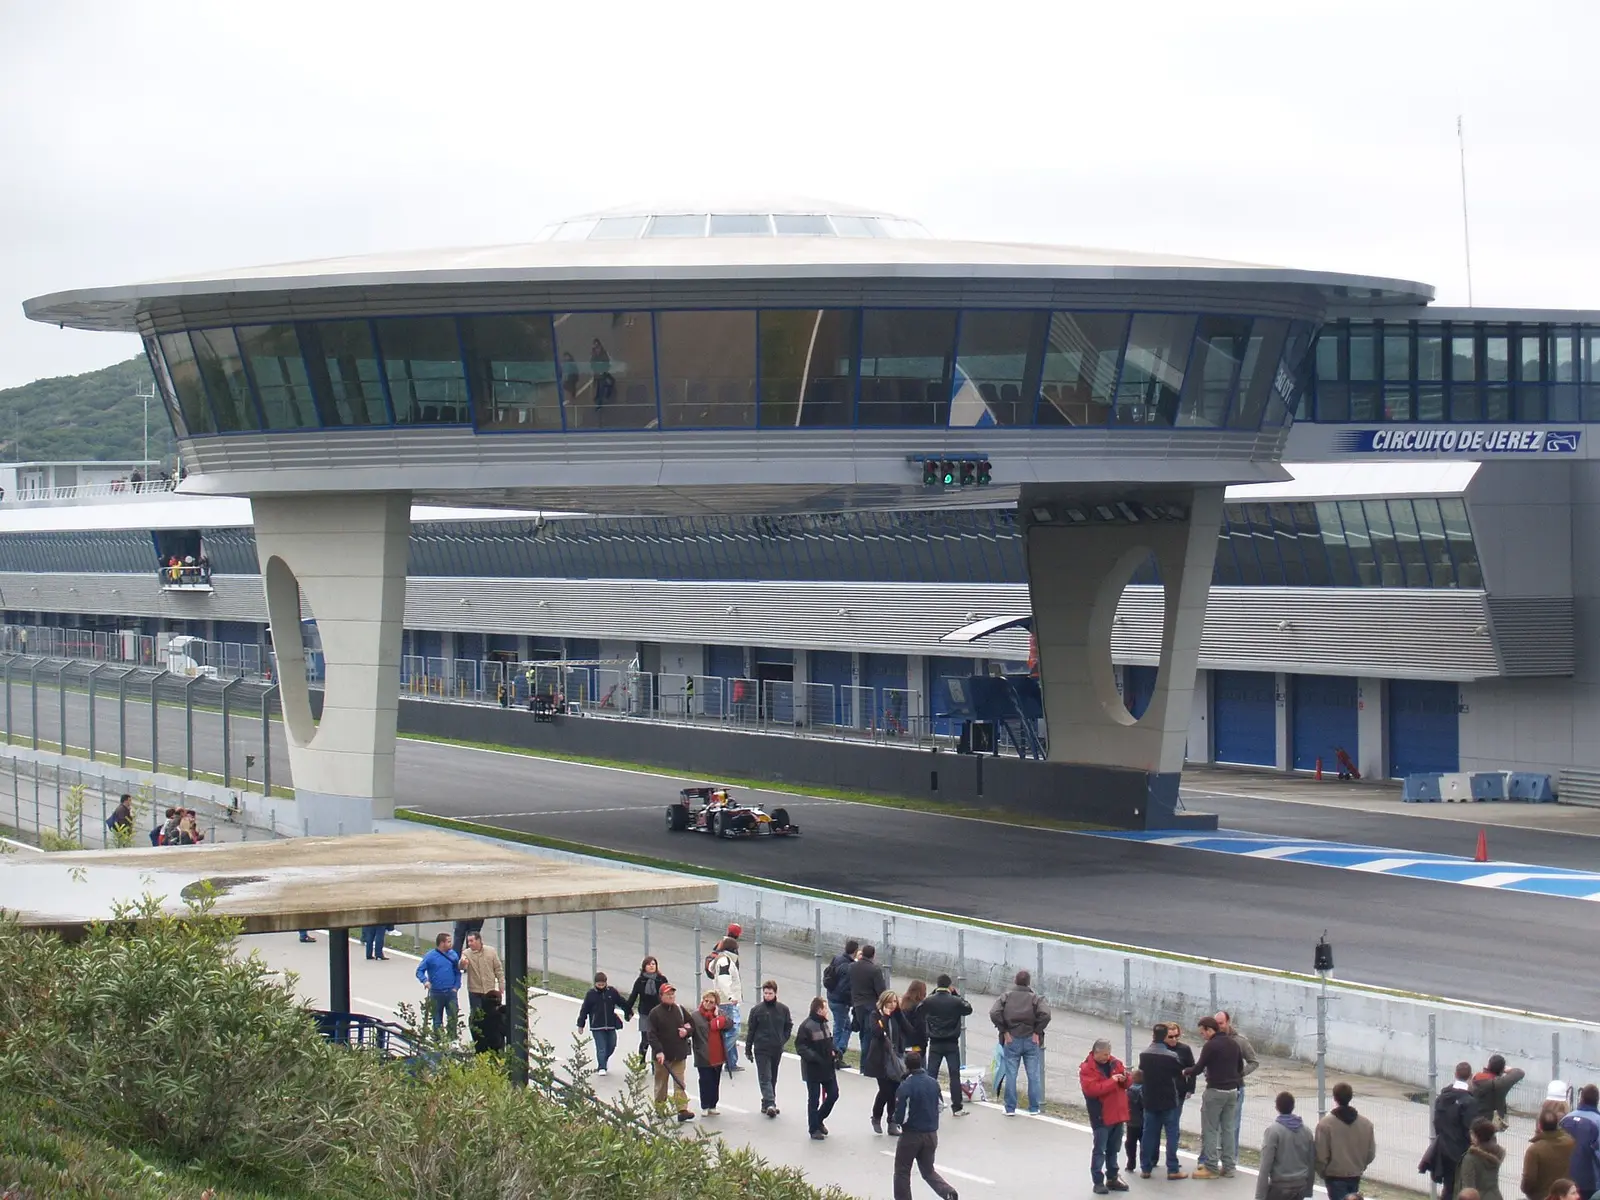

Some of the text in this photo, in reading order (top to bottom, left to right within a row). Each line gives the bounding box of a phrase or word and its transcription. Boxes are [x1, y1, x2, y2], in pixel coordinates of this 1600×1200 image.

[1372, 430, 1544, 450] CIRCUITO DE JEREZ
